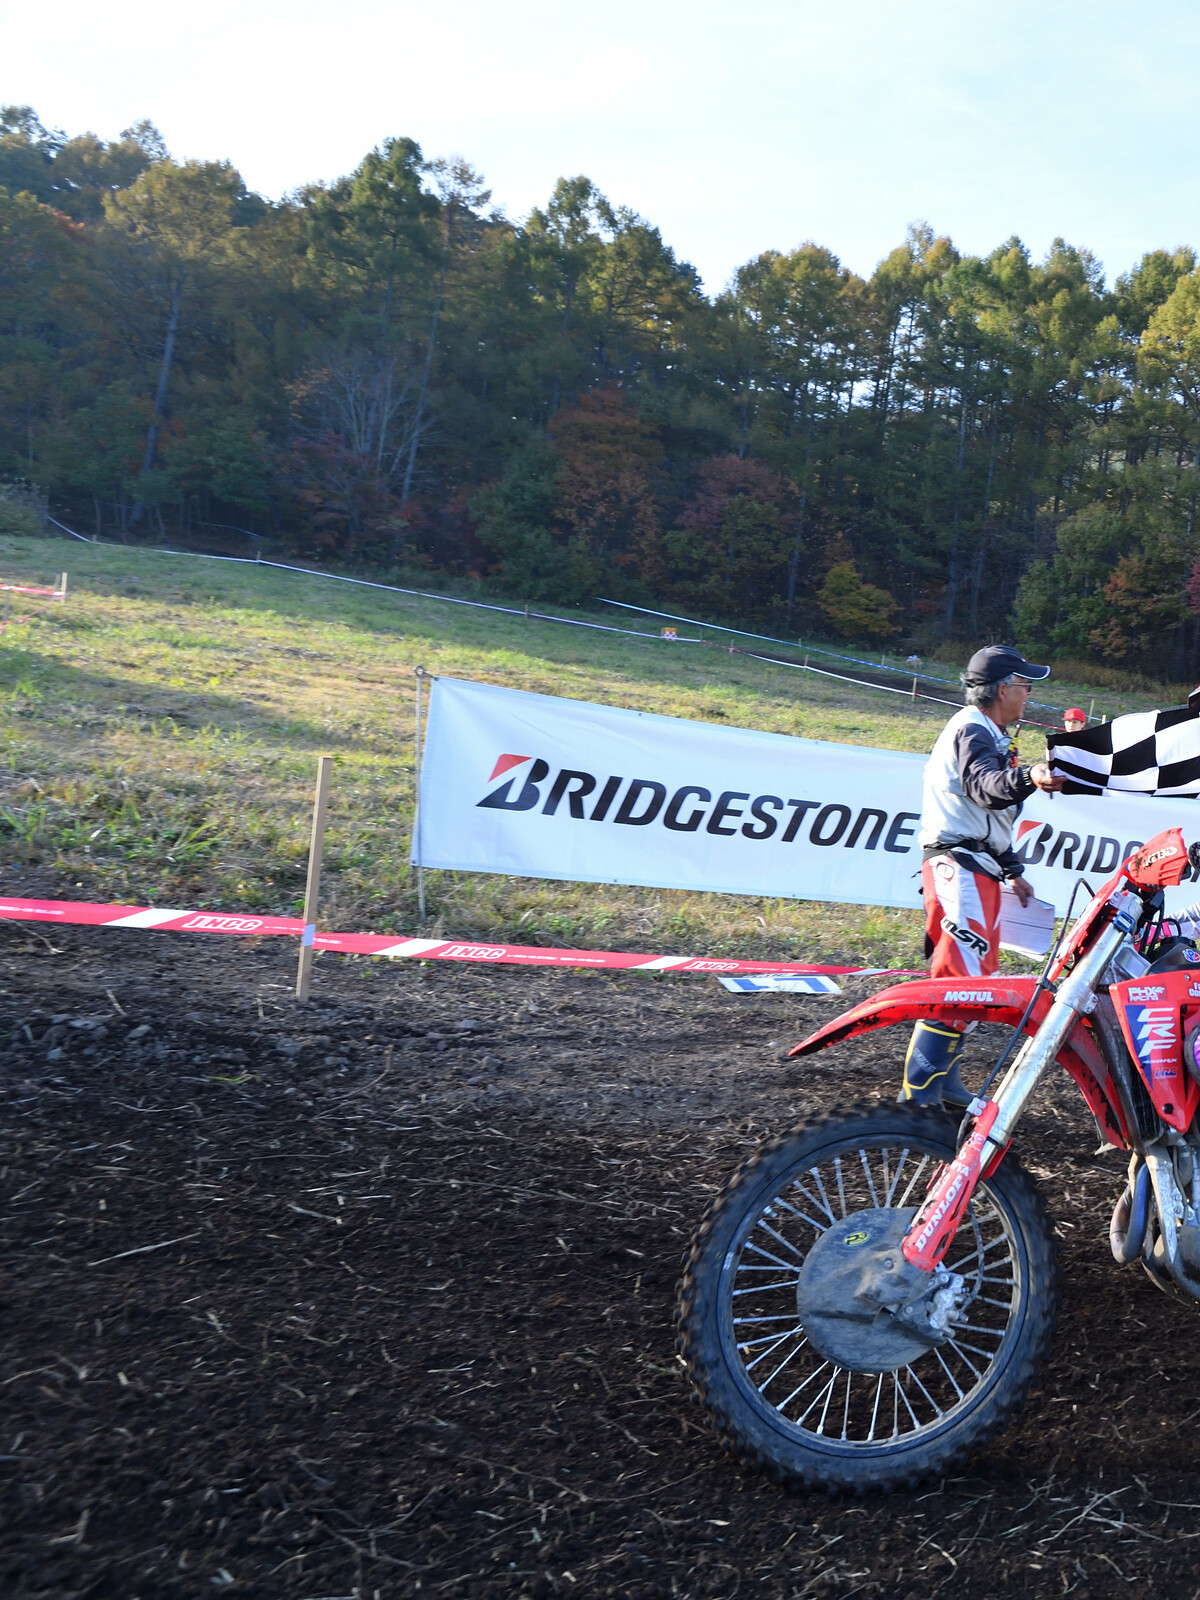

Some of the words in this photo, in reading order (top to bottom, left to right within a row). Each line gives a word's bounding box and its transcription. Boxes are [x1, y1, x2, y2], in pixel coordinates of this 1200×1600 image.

[475, 753, 921, 854] BRIDGESTONE
[182, 915, 263, 932] JNCC
[438, 944, 507, 961] JNCC
[943, 991, 994, 1002] MOTUL
[1136, 1007, 1177, 1058] CRF
[914, 1174, 963, 1252] DUNLOP
